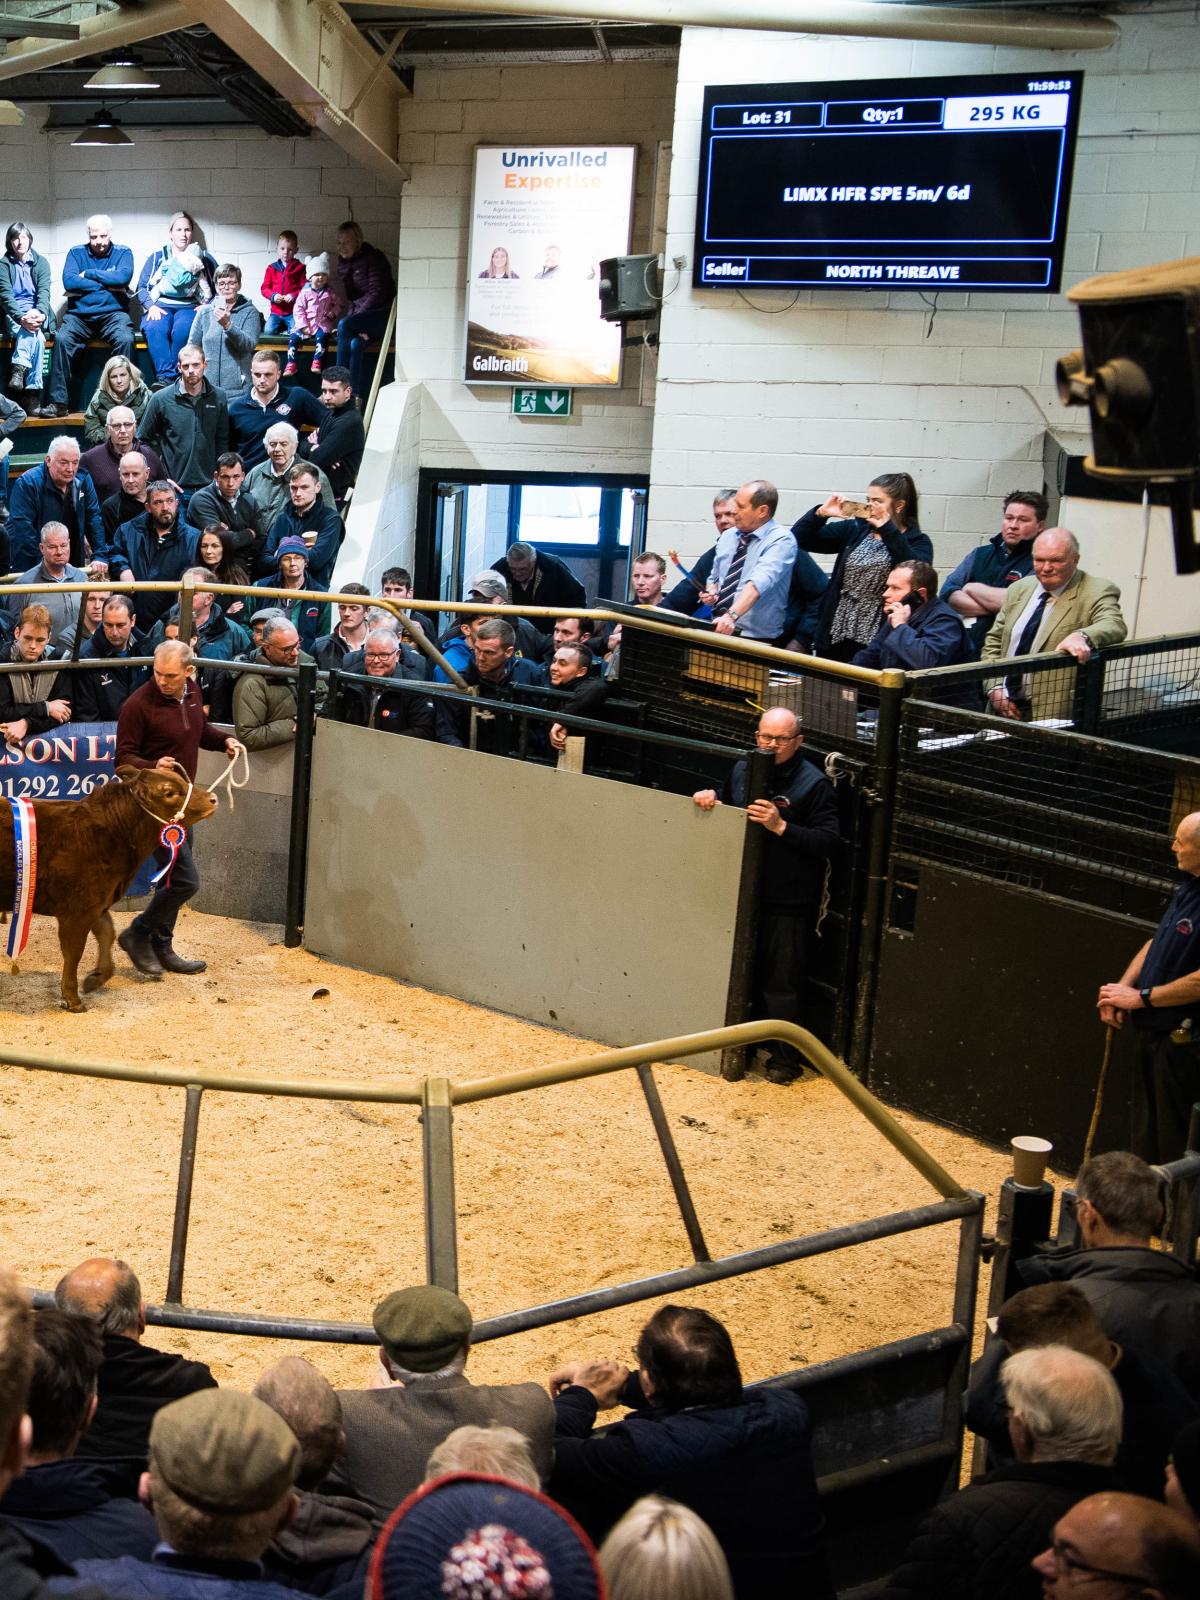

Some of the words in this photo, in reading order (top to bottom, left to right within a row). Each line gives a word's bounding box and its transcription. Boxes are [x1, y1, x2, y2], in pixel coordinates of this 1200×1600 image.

[1027, 80, 1071, 92] 11:59:53
[742, 111, 771, 125] Lot:
[774, 110, 792, 124] 31
[862, 106, 904, 124] Qty:1
[970, 105, 1006, 121] 295
[1012, 104, 1041, 120] KG
[501, 151, 608, 168] Unrivalled
[504, 172, 602, 192] Expertise
[783, 187, 829, 202] LIMX
[831, 187, 867, 201] HFR
[869, 186, 903, 201] SPE
[905, 186, 944, 203] 5m/
[946, 184, 971, 200] 6d
[705, 262, 746, 277] Seller
[825, 265, 884, 279] NORTH
[886, 265, 960, 280] THREAVE
[472, 354, 529, 374] Galbraith
[85, 734, 117, 762] LT
